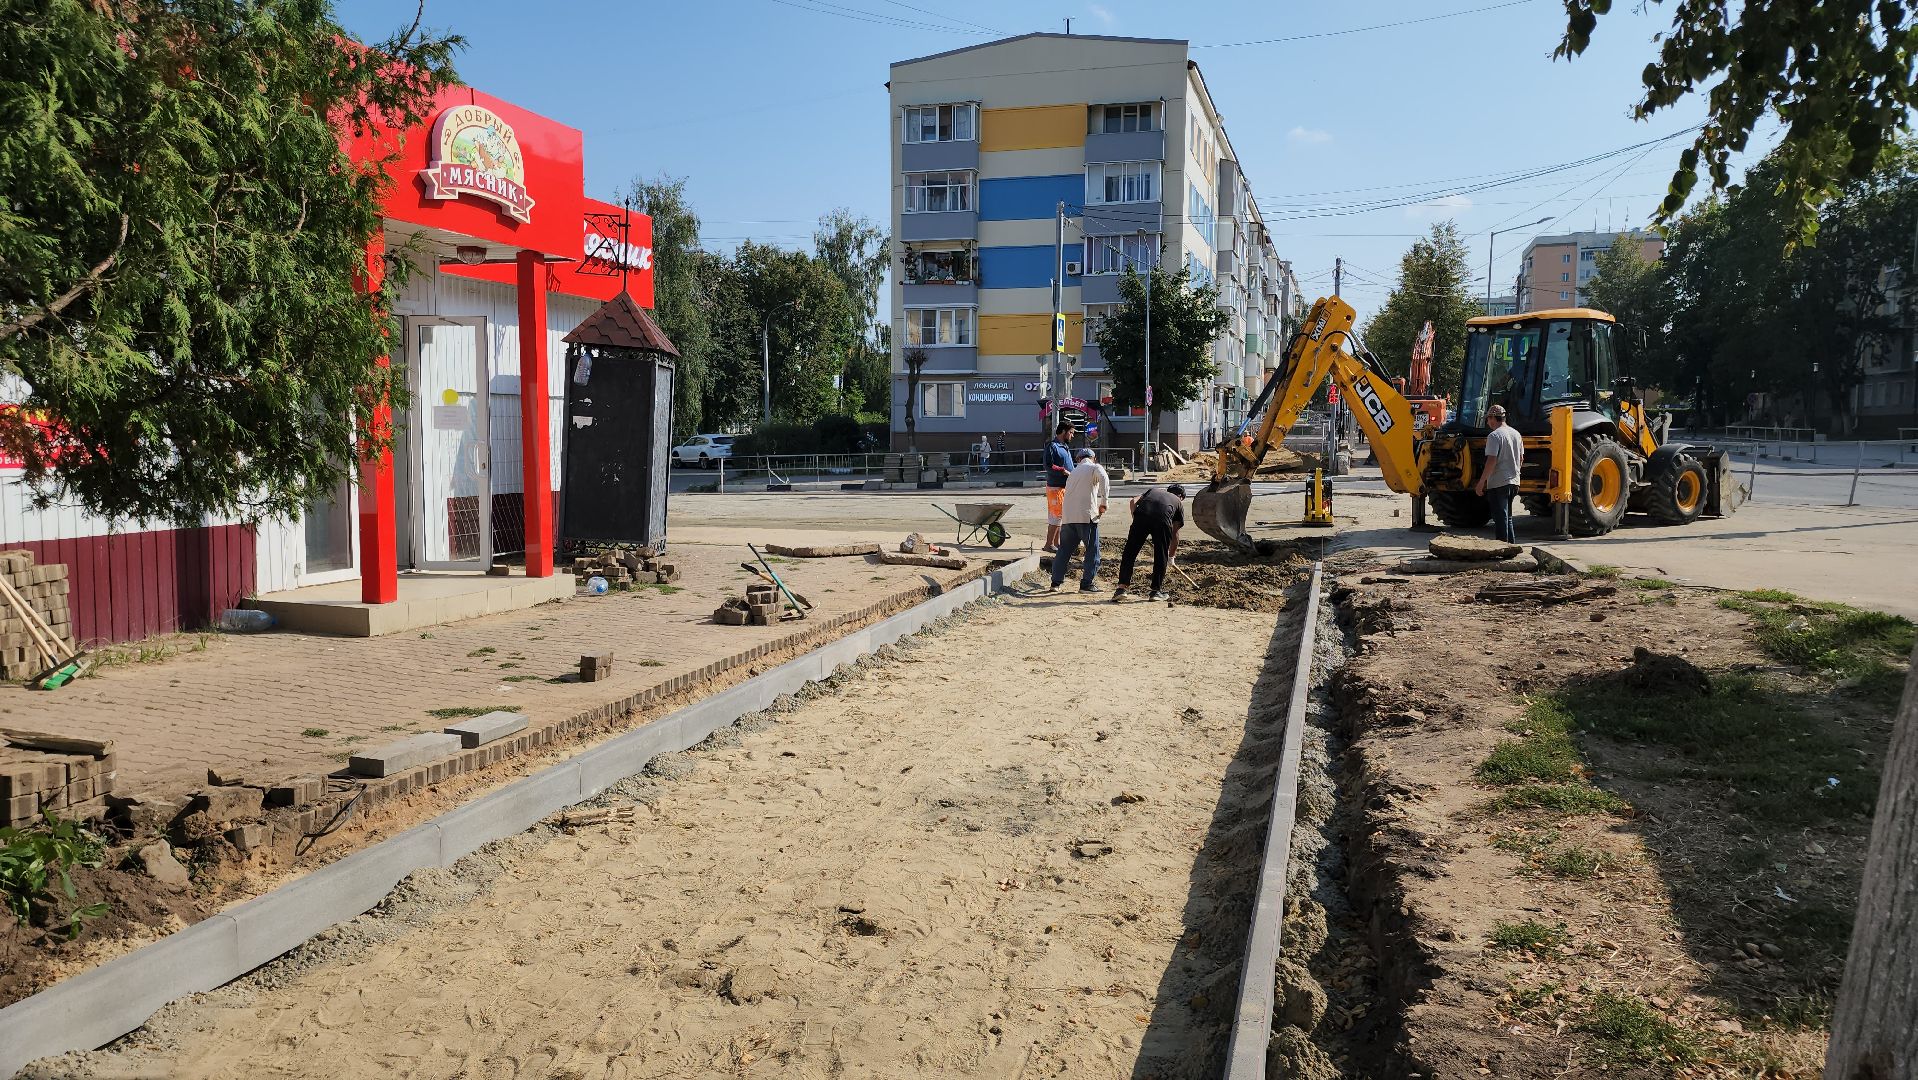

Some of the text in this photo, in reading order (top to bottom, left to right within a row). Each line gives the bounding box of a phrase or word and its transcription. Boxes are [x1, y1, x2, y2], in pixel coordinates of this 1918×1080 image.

[455, 109, 512, 144] ДОБРЫЙ
[449, 166, 518, 203] МЯСНИК
[973, 382, 1009, 390] ЛОМБАРД
[1355, 381, 1394, 433] JCB
